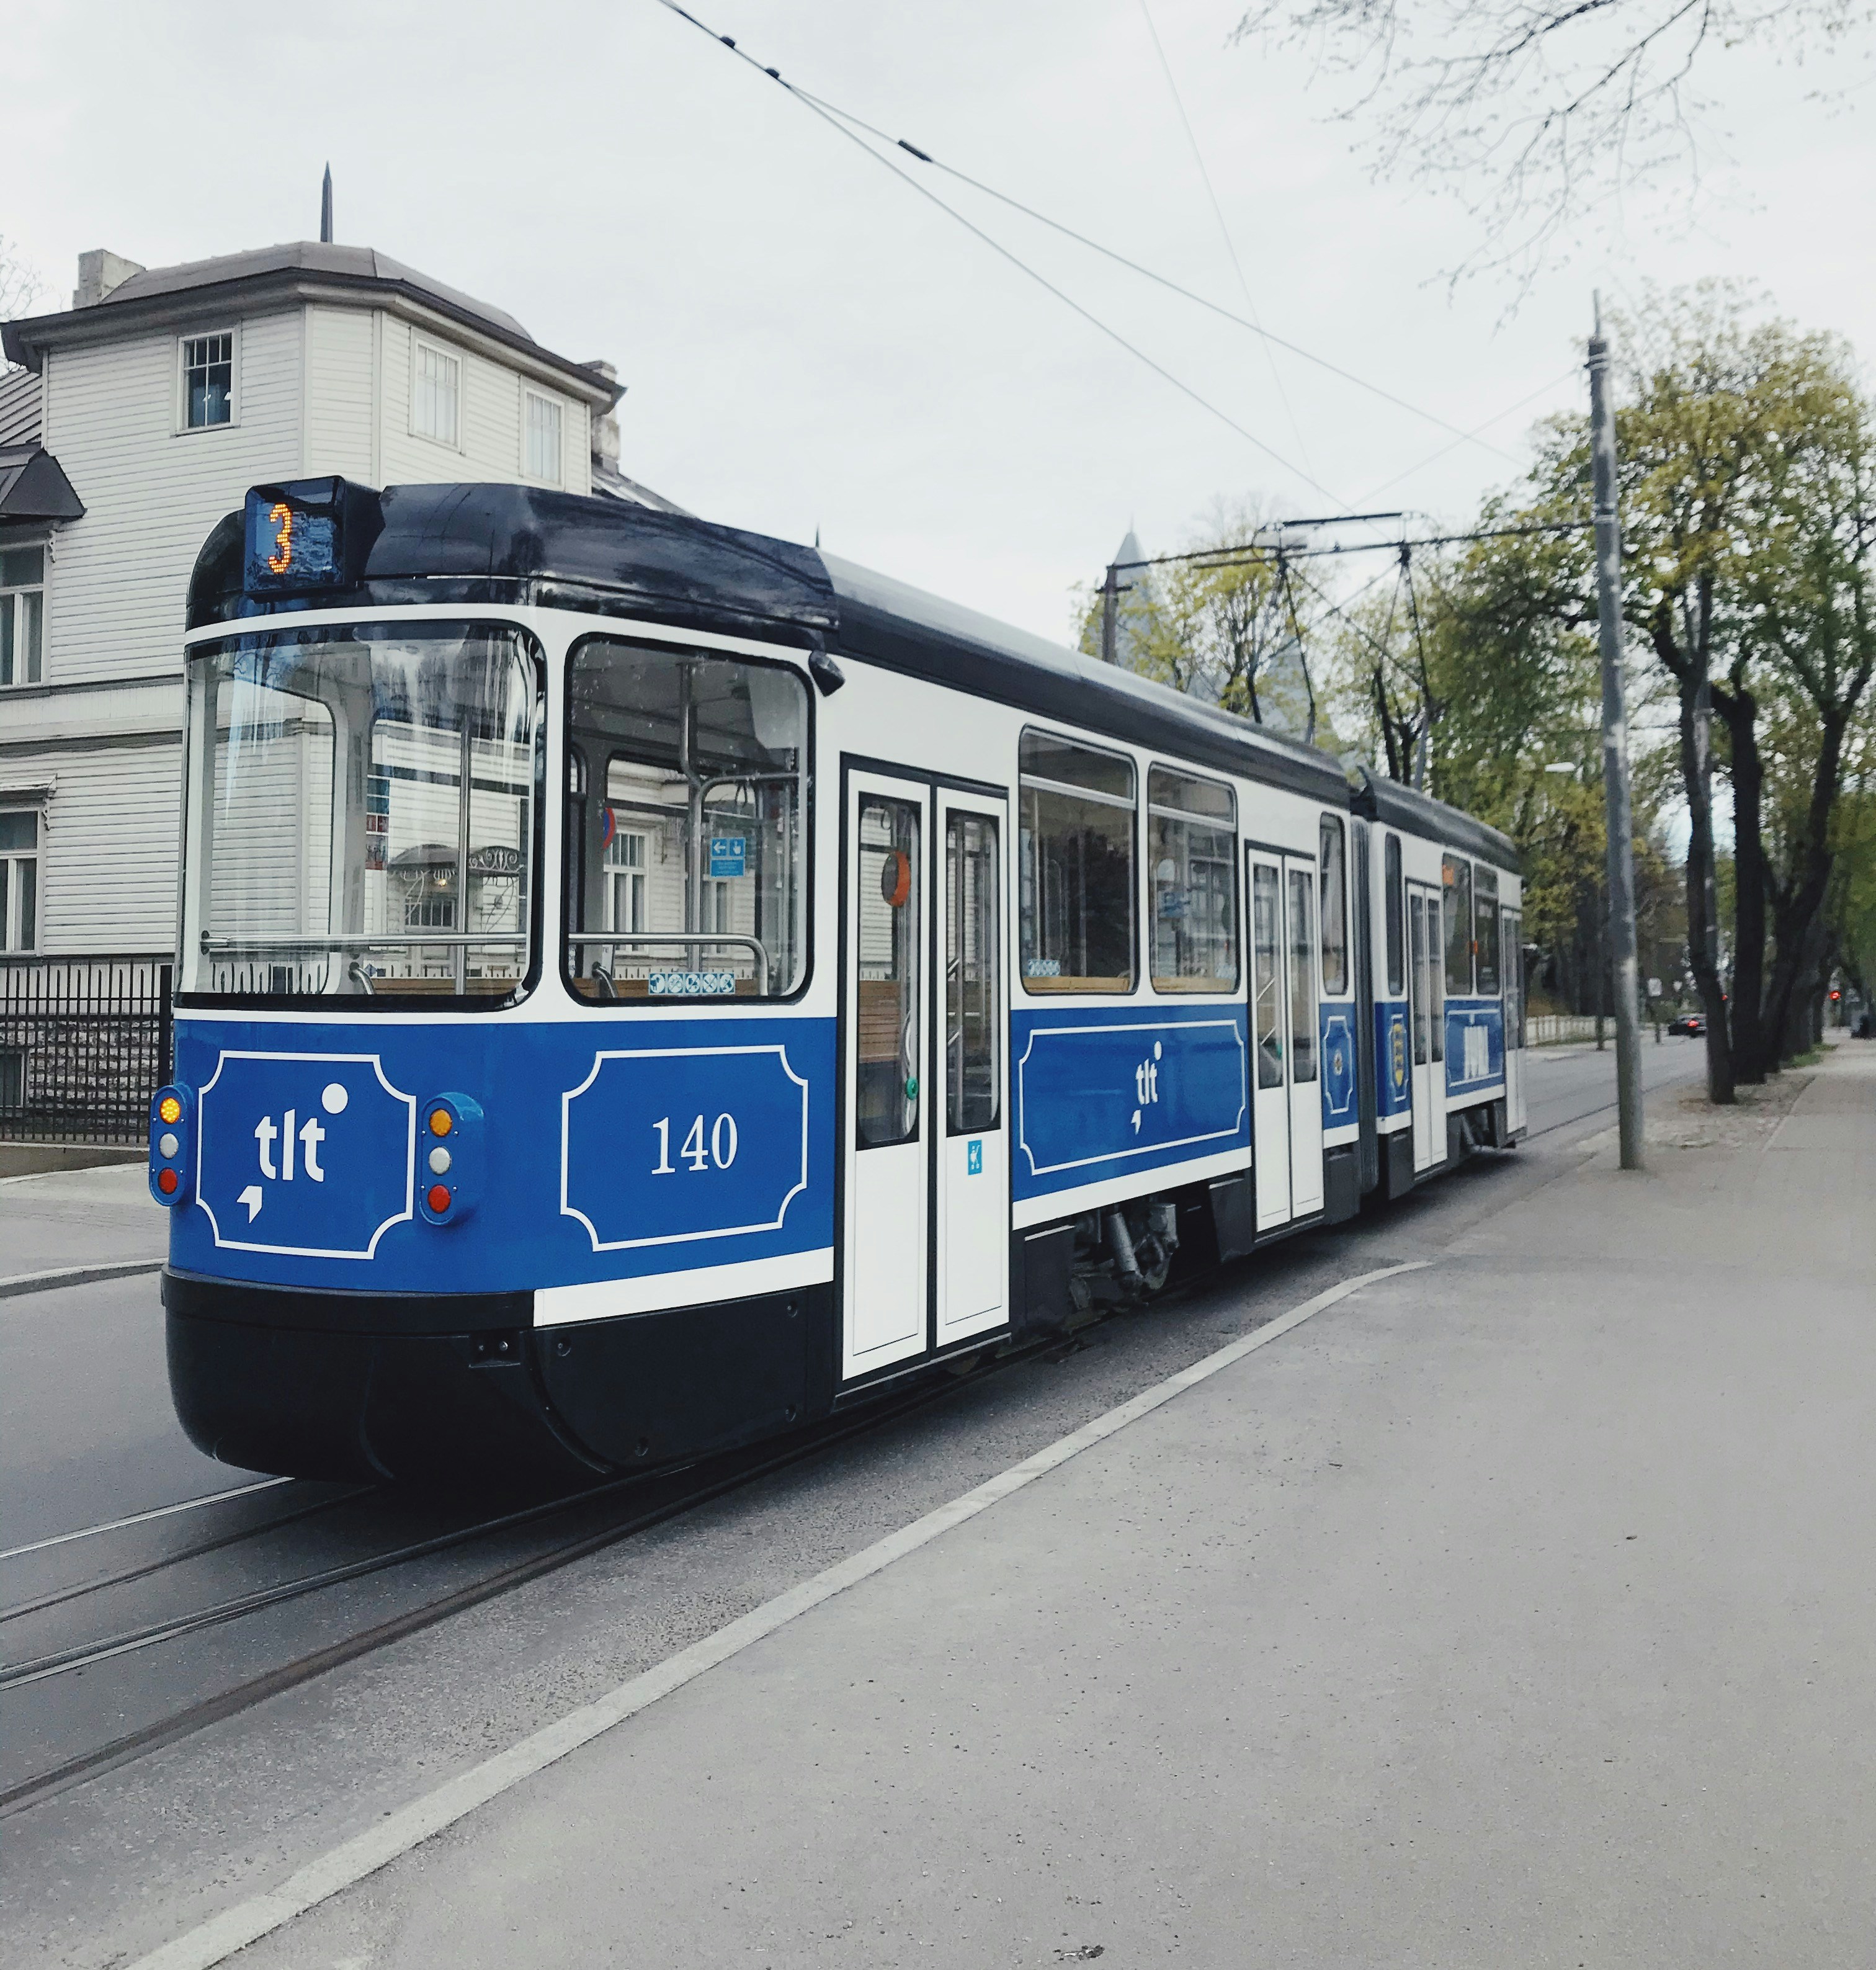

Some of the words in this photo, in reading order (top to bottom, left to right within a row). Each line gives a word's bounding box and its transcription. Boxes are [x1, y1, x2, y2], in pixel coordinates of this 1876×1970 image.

[268, 503, 292, 573] 3
[1135, 1058, 1158, 1105] tlt
[254, 1108, 326, 1183] tlt
[651, 1113, 738, 1175] 140
